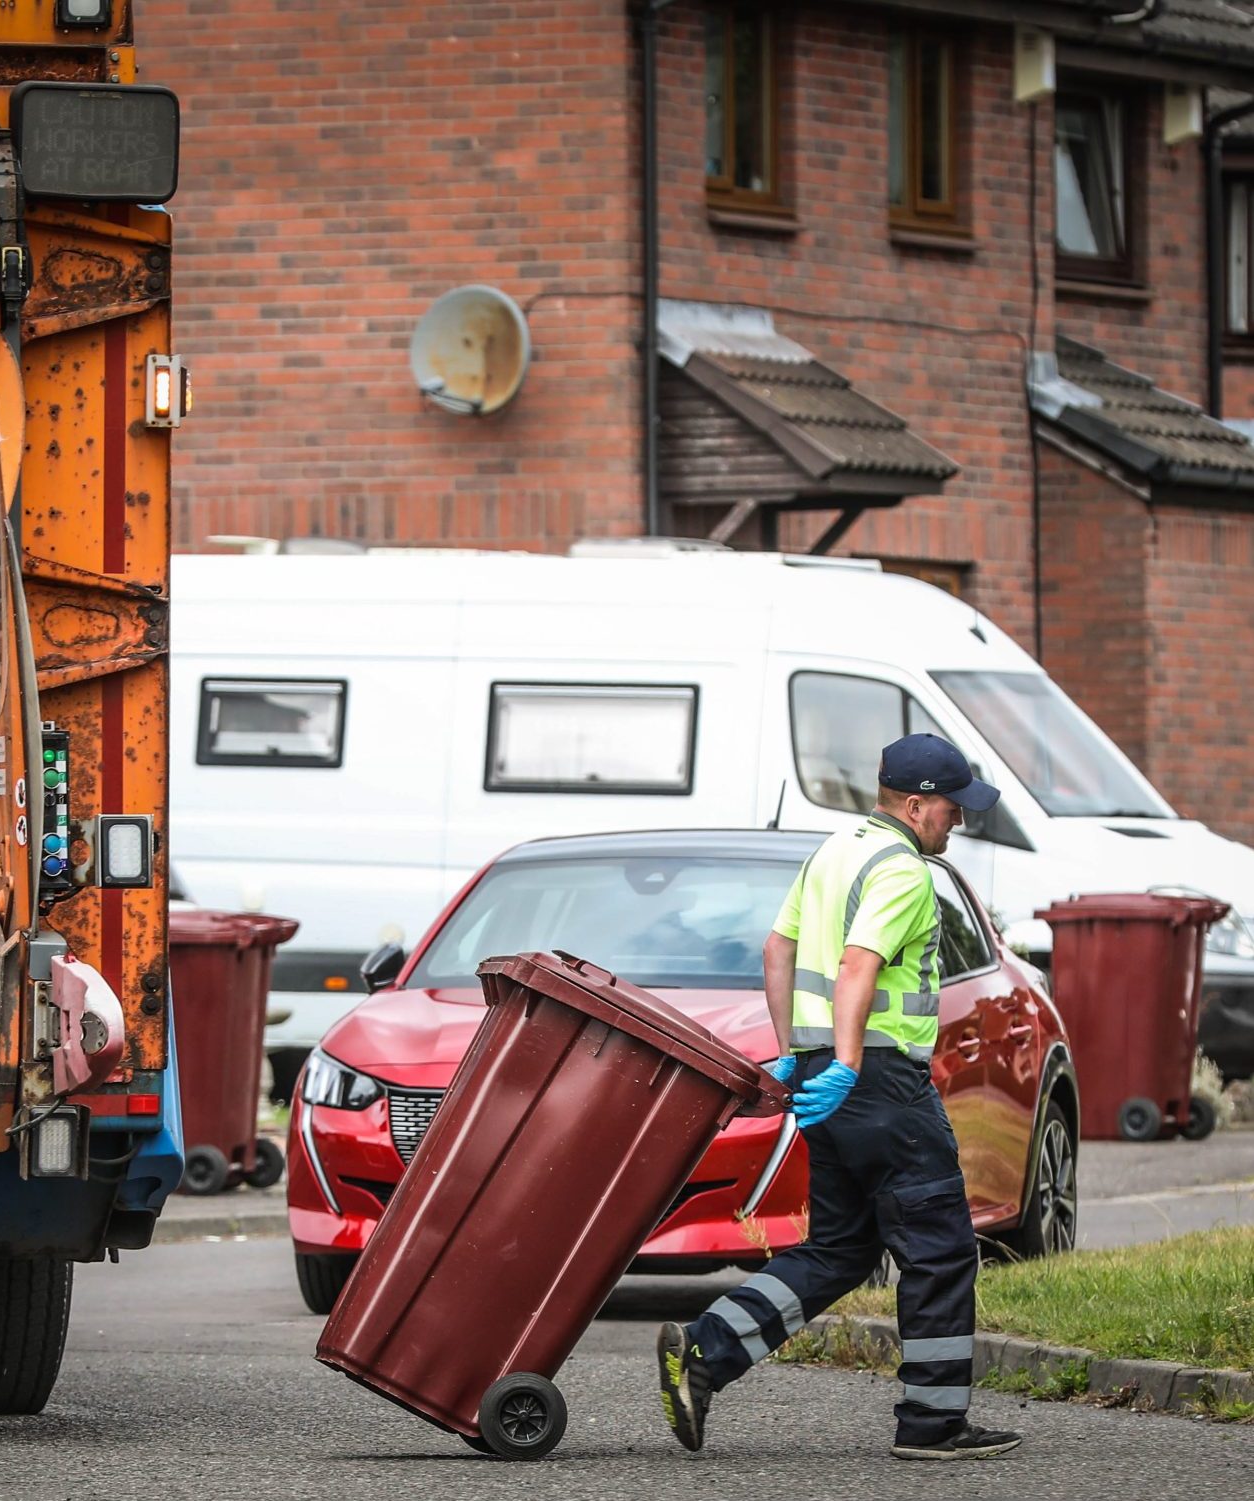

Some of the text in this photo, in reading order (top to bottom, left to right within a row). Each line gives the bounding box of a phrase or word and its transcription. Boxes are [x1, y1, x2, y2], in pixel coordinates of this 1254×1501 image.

[41, 98, 155, 129] CAUTION
[33, 128, 160, 157] WORKERS
[41, 156, 153, 187] AT REAR
